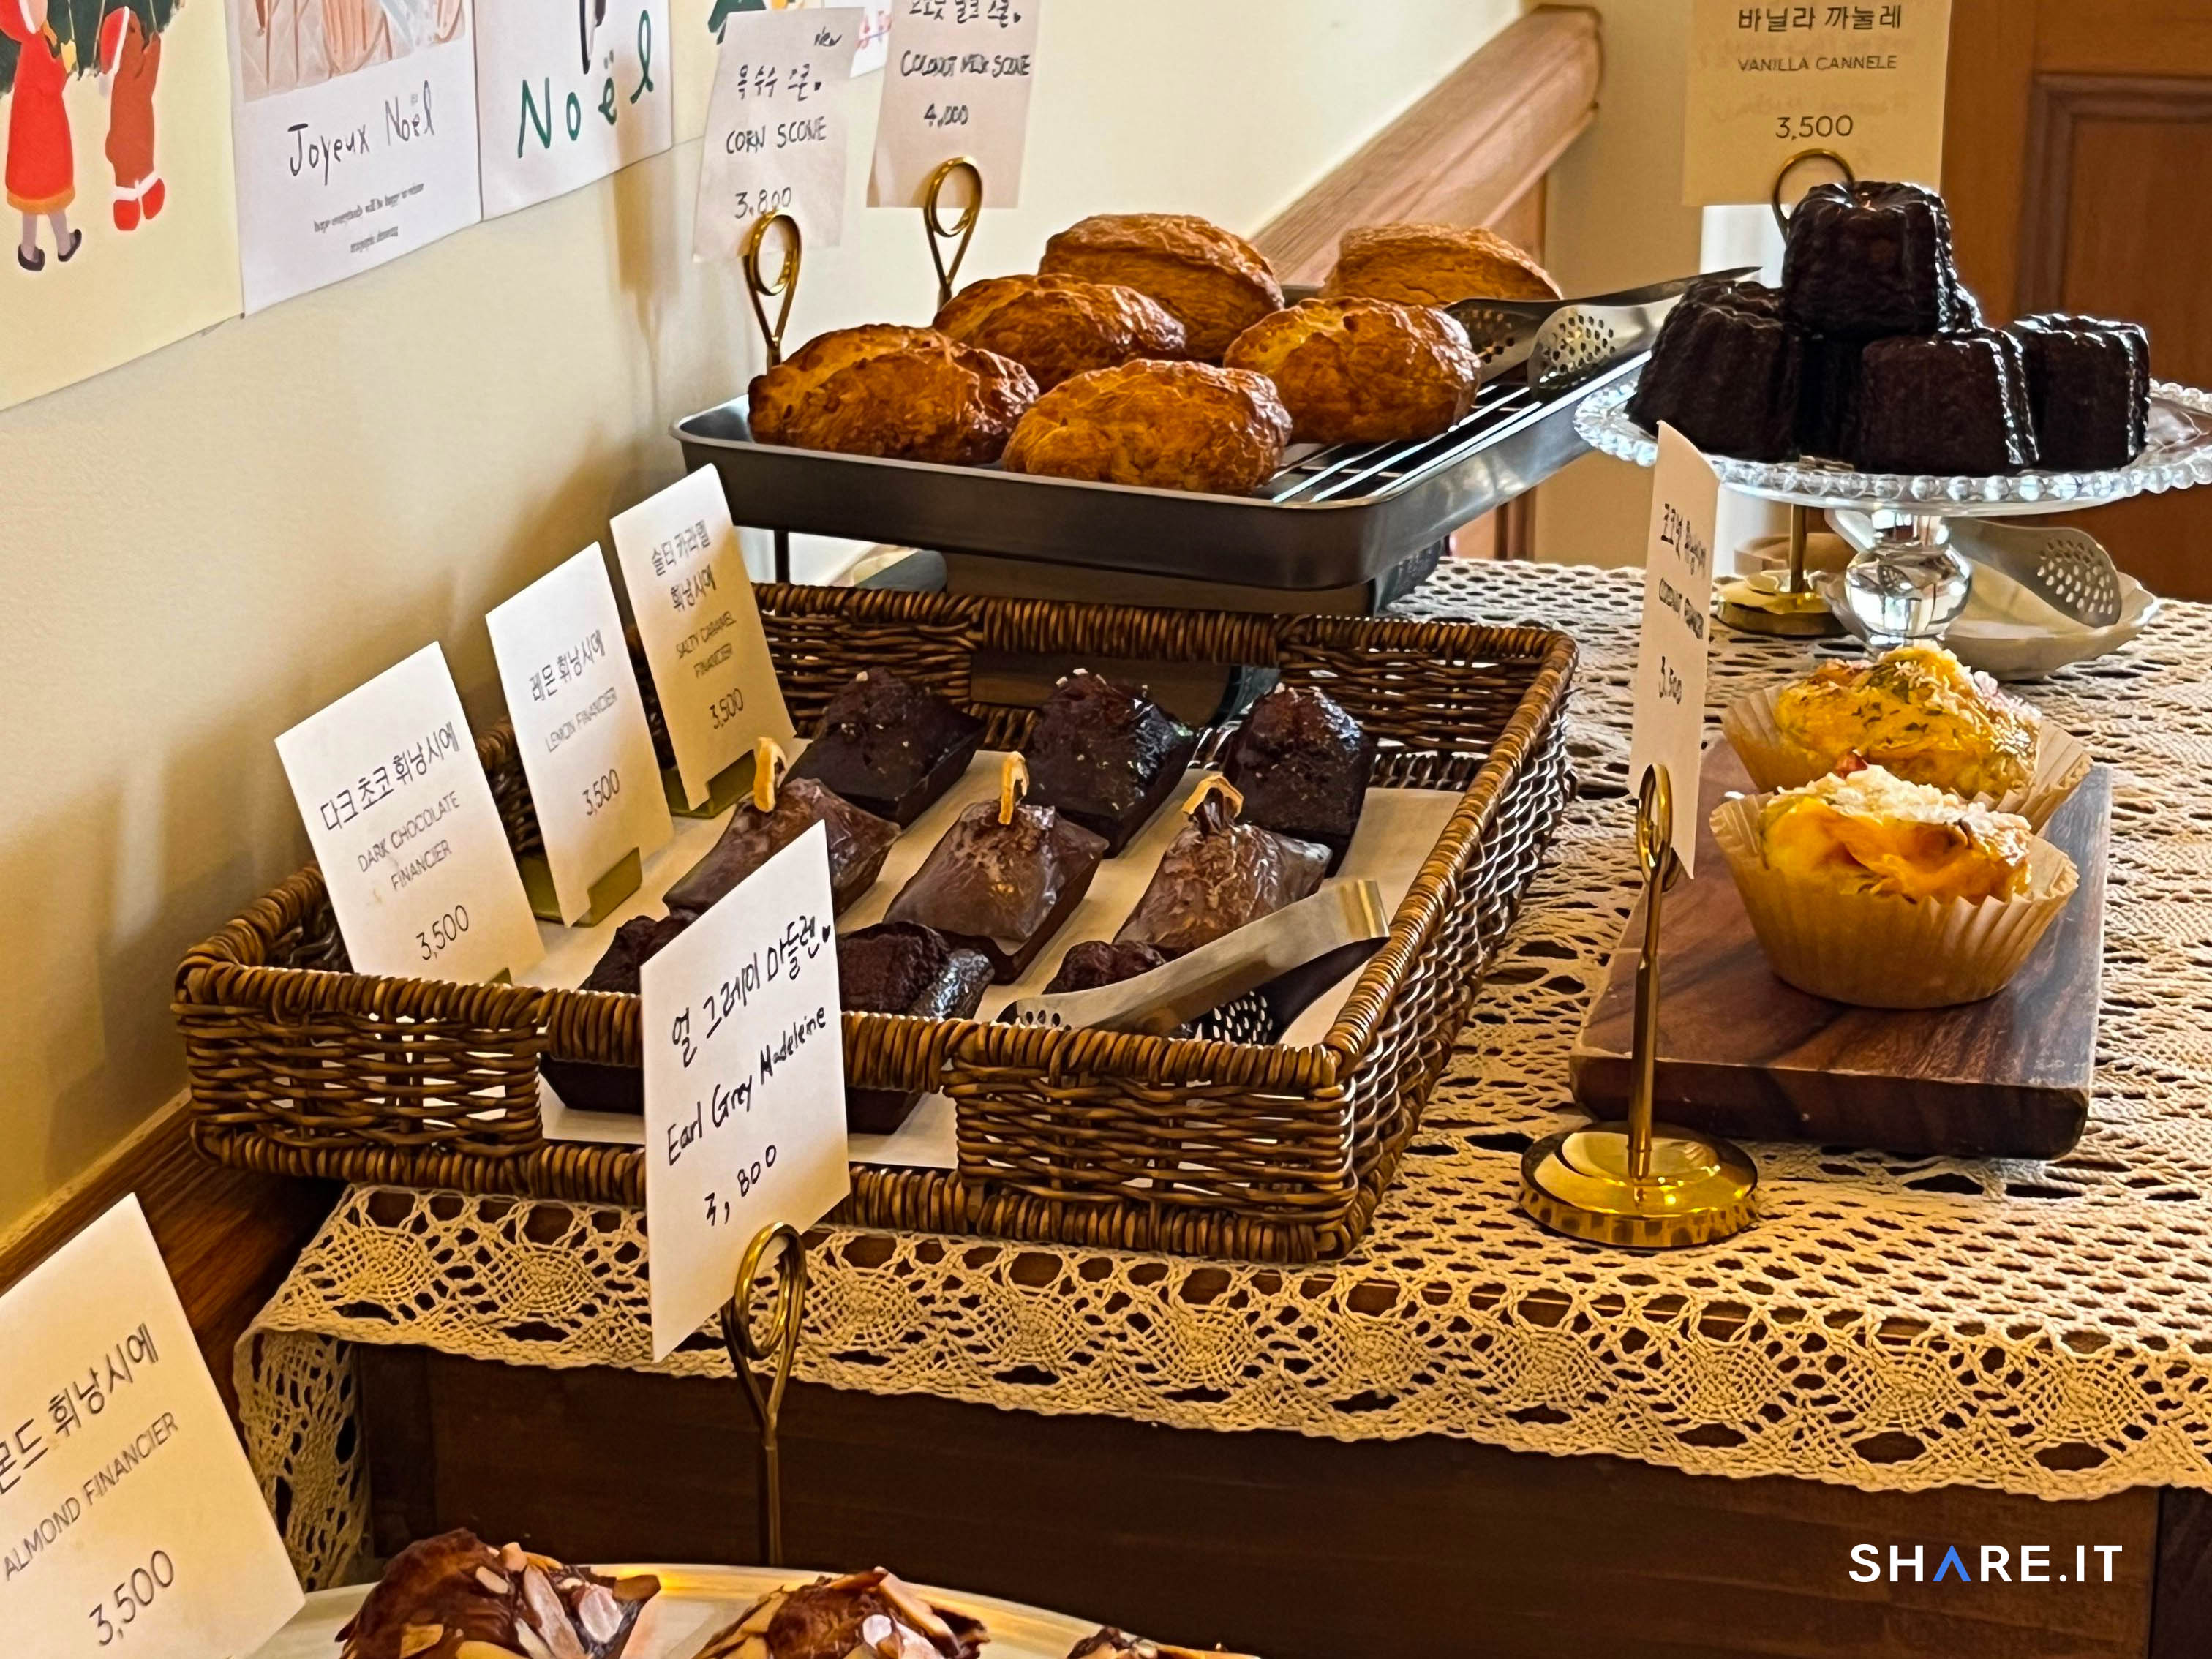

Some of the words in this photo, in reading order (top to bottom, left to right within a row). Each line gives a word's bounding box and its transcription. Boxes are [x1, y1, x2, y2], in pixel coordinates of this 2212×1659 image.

[1738, 6, 1816, 32] 바닐라
[1824, 4, 1902, 31] 까눌레
[518, 9, 654, 159] Noël
[1737, 56, 1808, 72] VANILLA
[1816, 55, 1897, 71] CANNELE
[287, 123, 370, 185] Joyeux
[385, 80, 434, 146] Noël
[726, 125, 765, 154] CORN
[776, 116, 827, 148] SCONE
[1775, 114, 1854, 141] 3,500
[529, 664, 557, 701] 레몬
[557, 629, 606, 683] 휘낭시에
[545, 718, 576, 753] LEMON
[709, 688, 744, 730] 3,500
[320, 789, 359, 830] 다크
[358, 766, 394, 810] 초코
[393, 721, 460, 785] 휘낭시에
[582, 768, 620, 816] 3,500
[358, 837, 391, 872] DARK
[391, 791, 461, 849] CHOCOLATE
[391, 839, 452, 891] FINANCIER
[416, 905, 469, 960] 3,500
[672, 1007, 697, 1068] 얼
[703, 952, 761, 1039] 그레이
[668, 1101, 703, 1166] Earl
[712, 1075, 753, 1129] Grey
[760, 1007, 826, 1085] Madeleine
[48, 1322, 159, 1438] 휘낭시에
[2, 1497, 81, 1581] ALMOND
[83, 1411, 178, 1507] FINANCIER
[89, 1549, 175, 1646] 3,500
